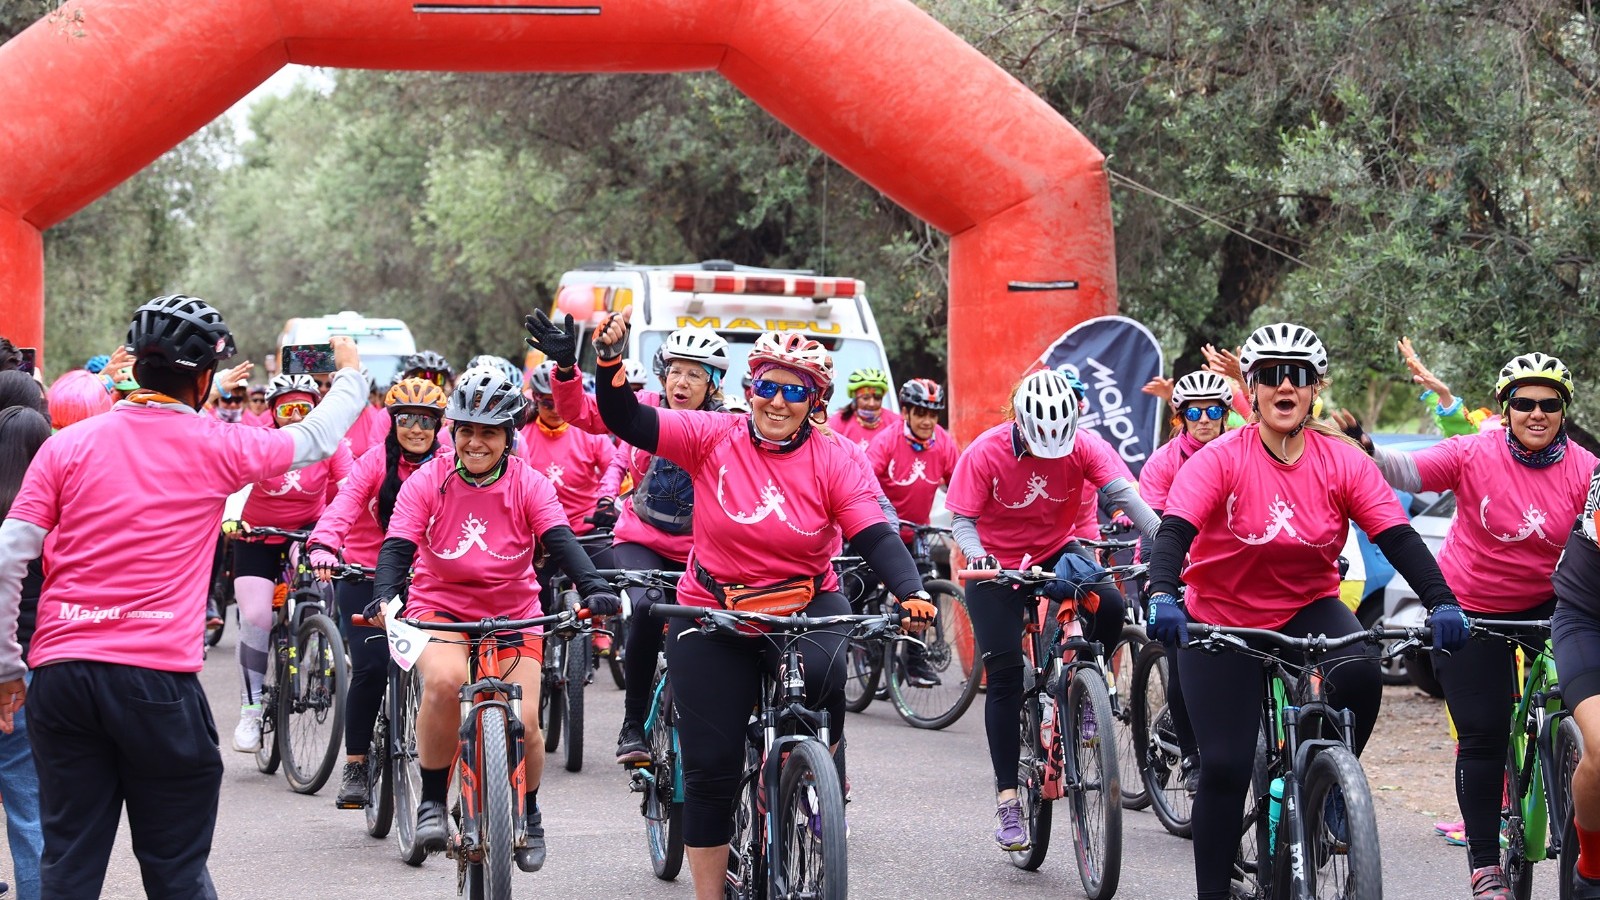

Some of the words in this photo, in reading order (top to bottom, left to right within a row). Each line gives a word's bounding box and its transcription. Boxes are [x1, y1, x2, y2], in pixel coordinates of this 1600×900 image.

[676, 316, 841, 335] MAIPU
[1086, 357, 1146, 463] Maipu
[58, 602, 121, 623] Maipú
[1290, 842, 1304, 882] FOX
